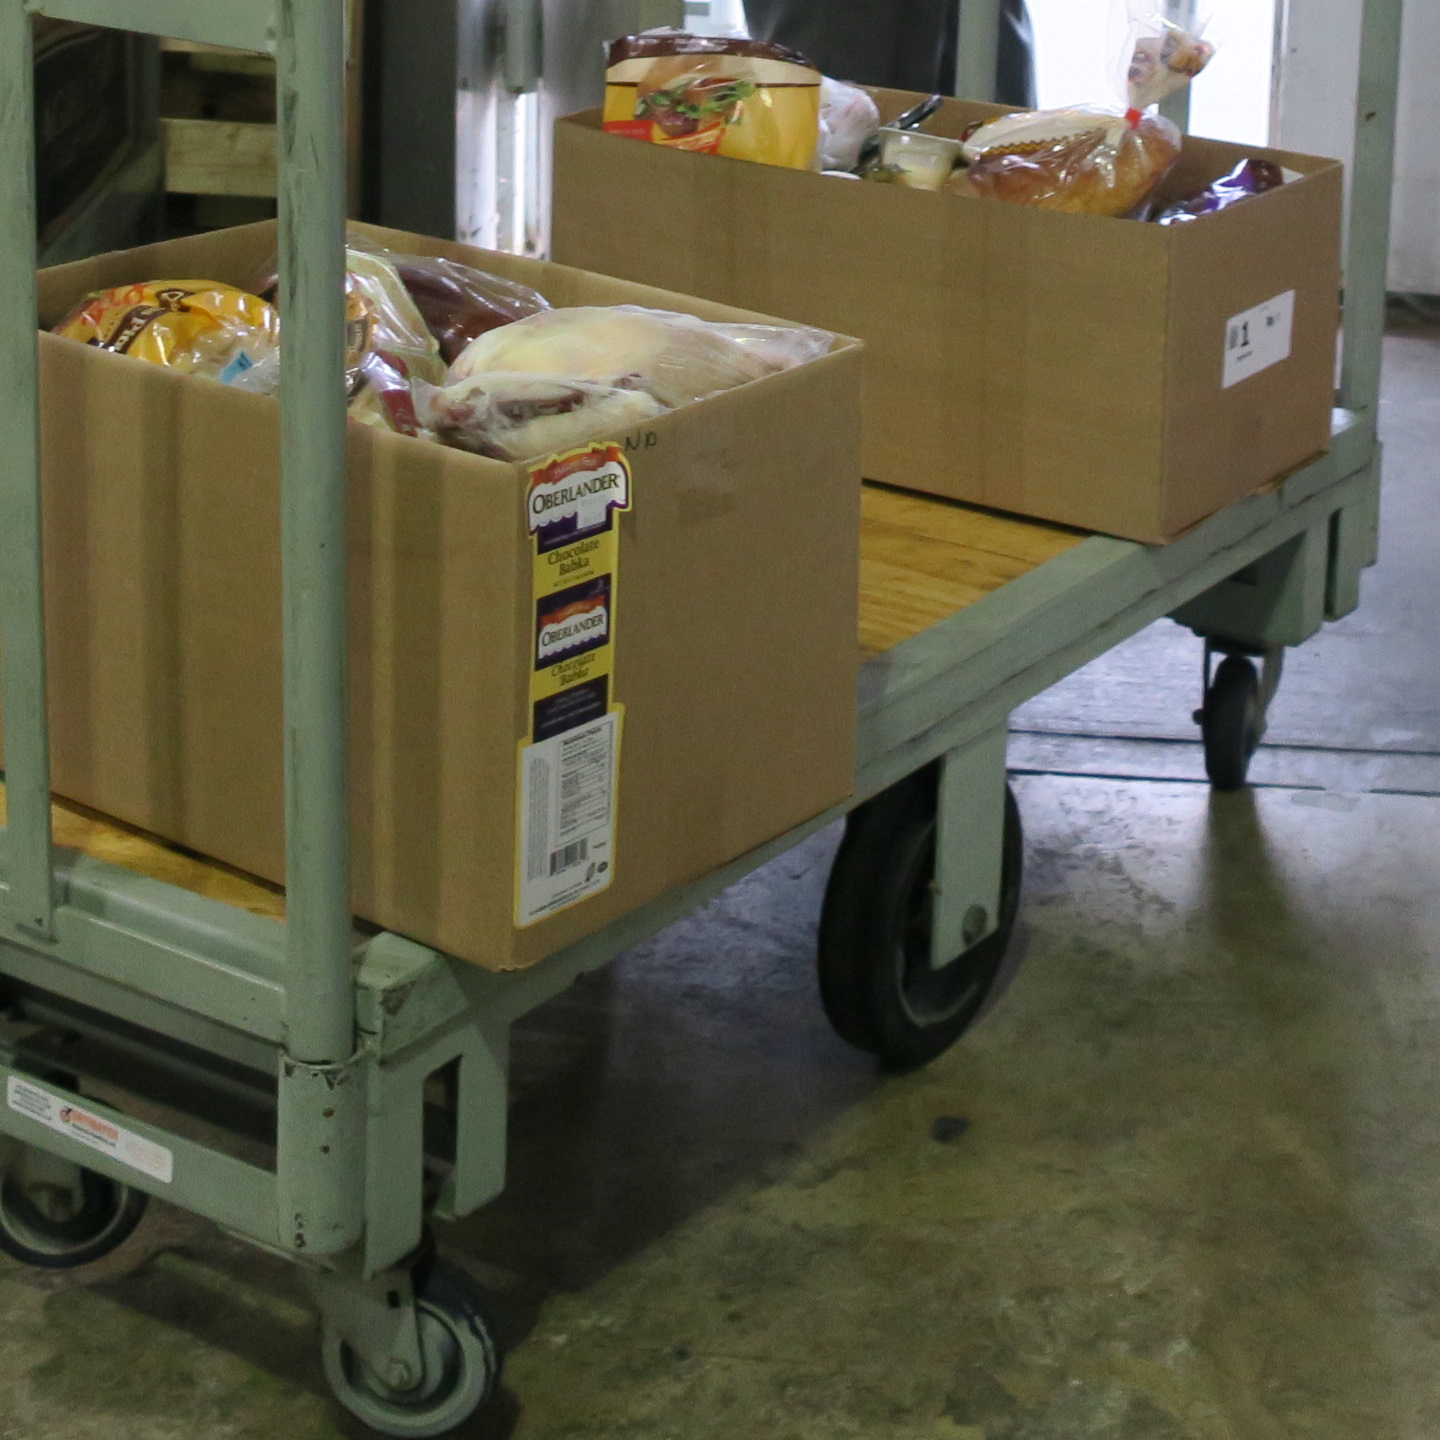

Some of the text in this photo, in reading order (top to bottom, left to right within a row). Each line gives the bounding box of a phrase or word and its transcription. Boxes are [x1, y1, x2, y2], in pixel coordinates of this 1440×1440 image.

[532, 472, 621, 515] OBERLANDER
[547, 539, 600, 566] Chocolate
[558, 557, 591, 577] Babka
[541, 613, 605, 648] OBERLANDER
